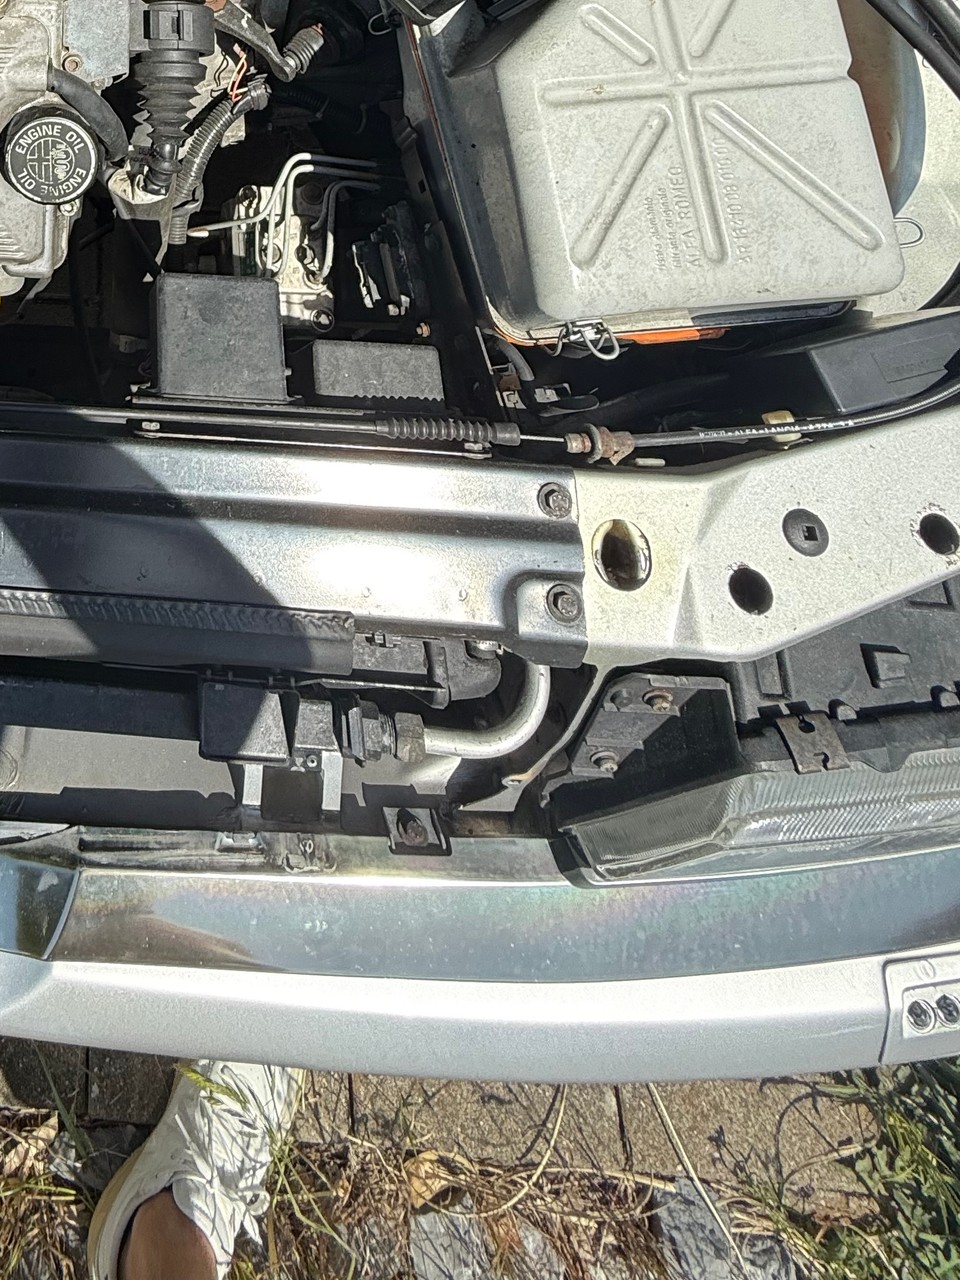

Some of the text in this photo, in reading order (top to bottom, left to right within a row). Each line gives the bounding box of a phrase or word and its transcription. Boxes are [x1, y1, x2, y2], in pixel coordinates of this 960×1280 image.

[15, 124, 85, 155] ENGINE OIL
[17, 167, 36, 190] OIL
[40, 167, 87, 197] ENGINE
[668, 166, 703, 268] ALFA ROMEO
